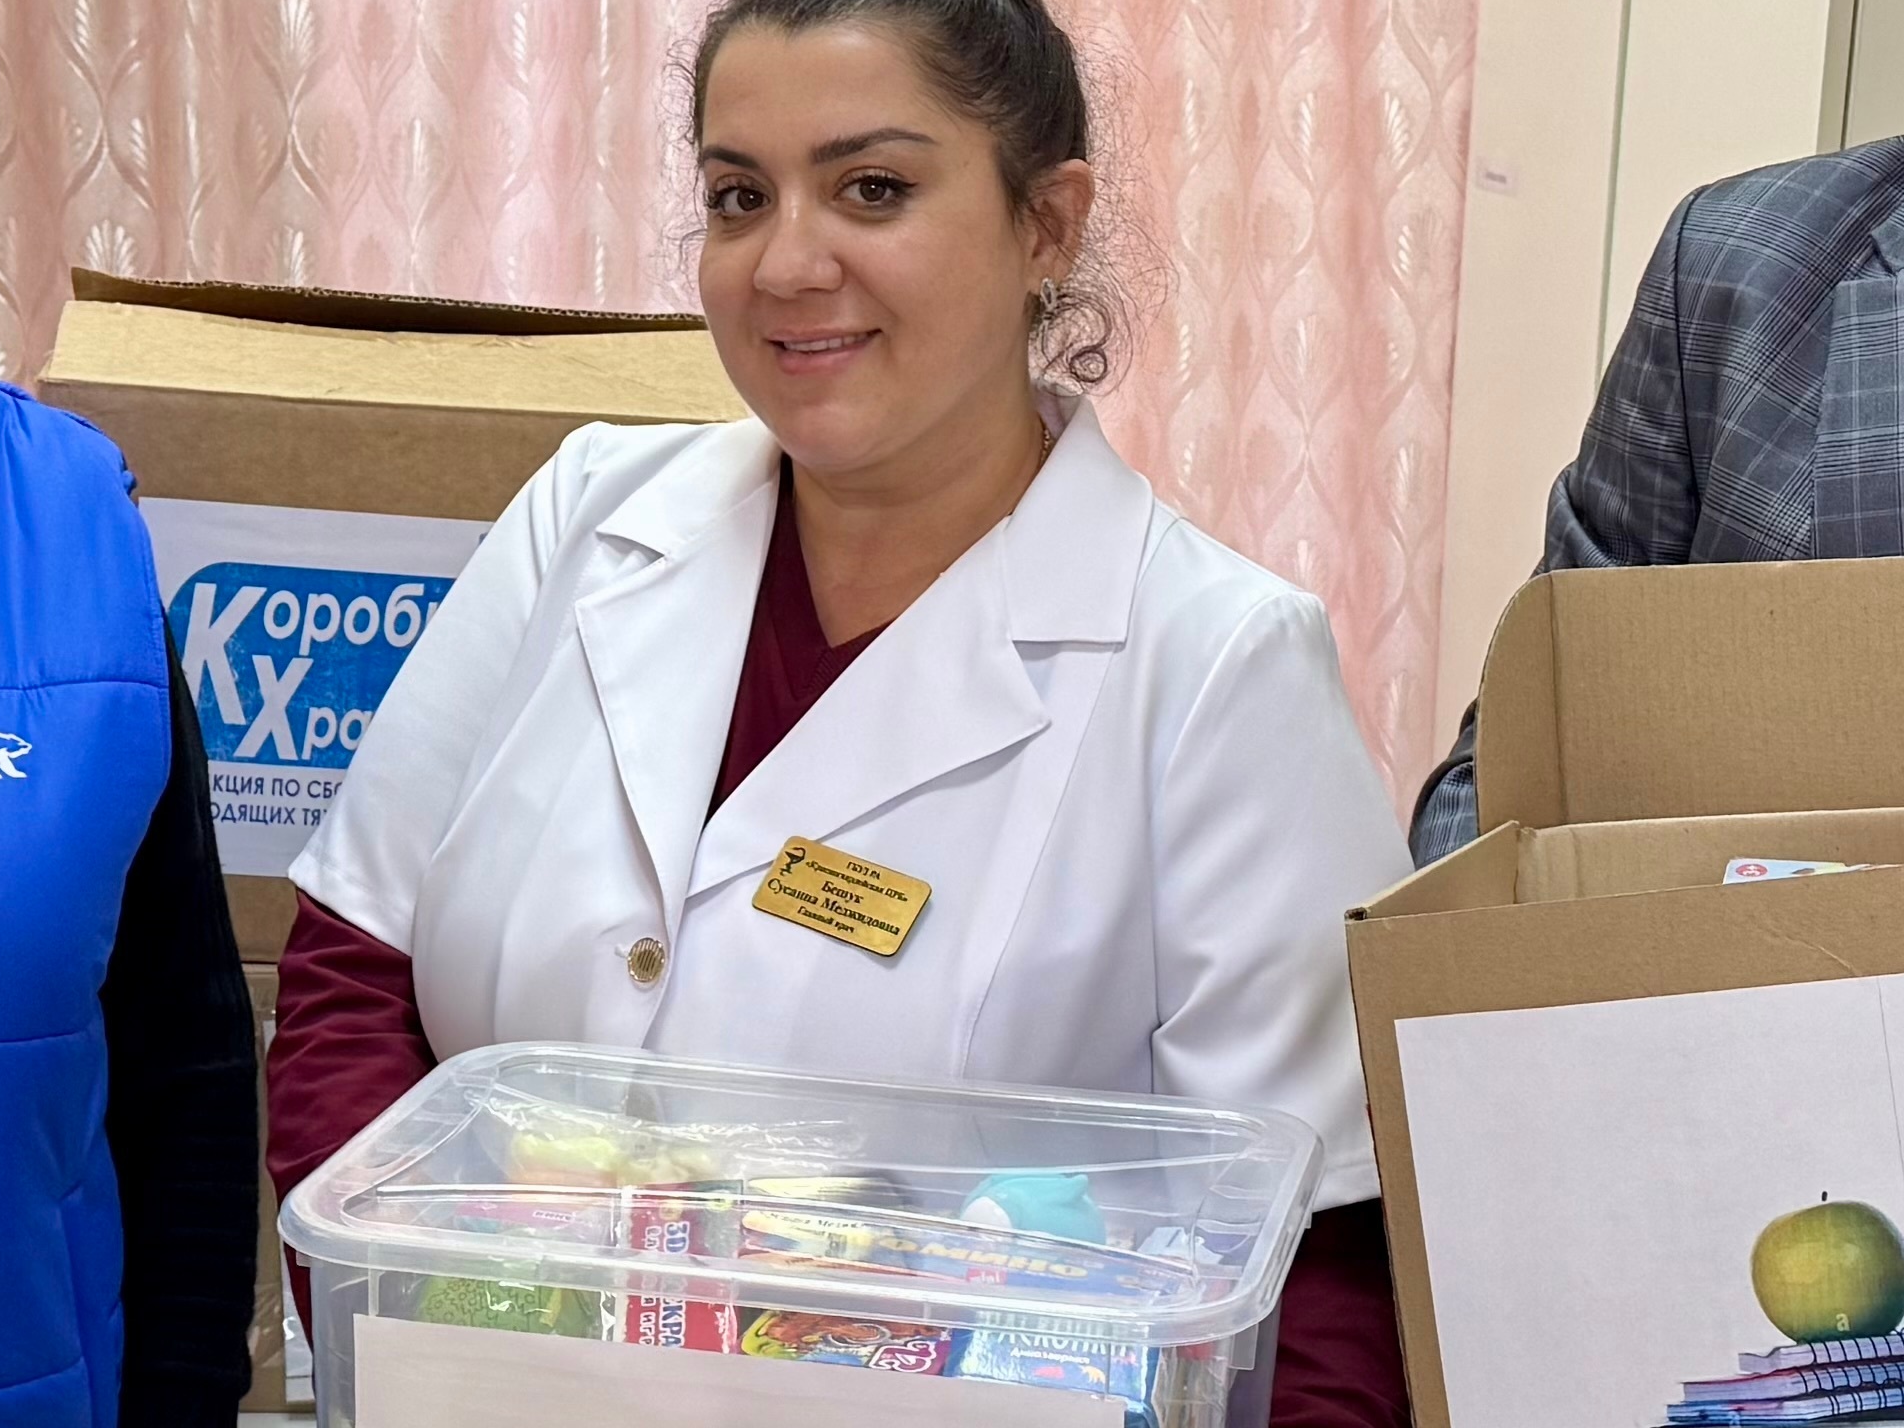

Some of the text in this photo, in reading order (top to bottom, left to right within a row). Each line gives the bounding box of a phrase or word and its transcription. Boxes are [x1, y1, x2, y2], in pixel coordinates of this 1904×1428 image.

[181, 582, 439, 726] Короб
[271, 777, 300, 798] ПО
[302, 807, 327, 827] ТЯ
